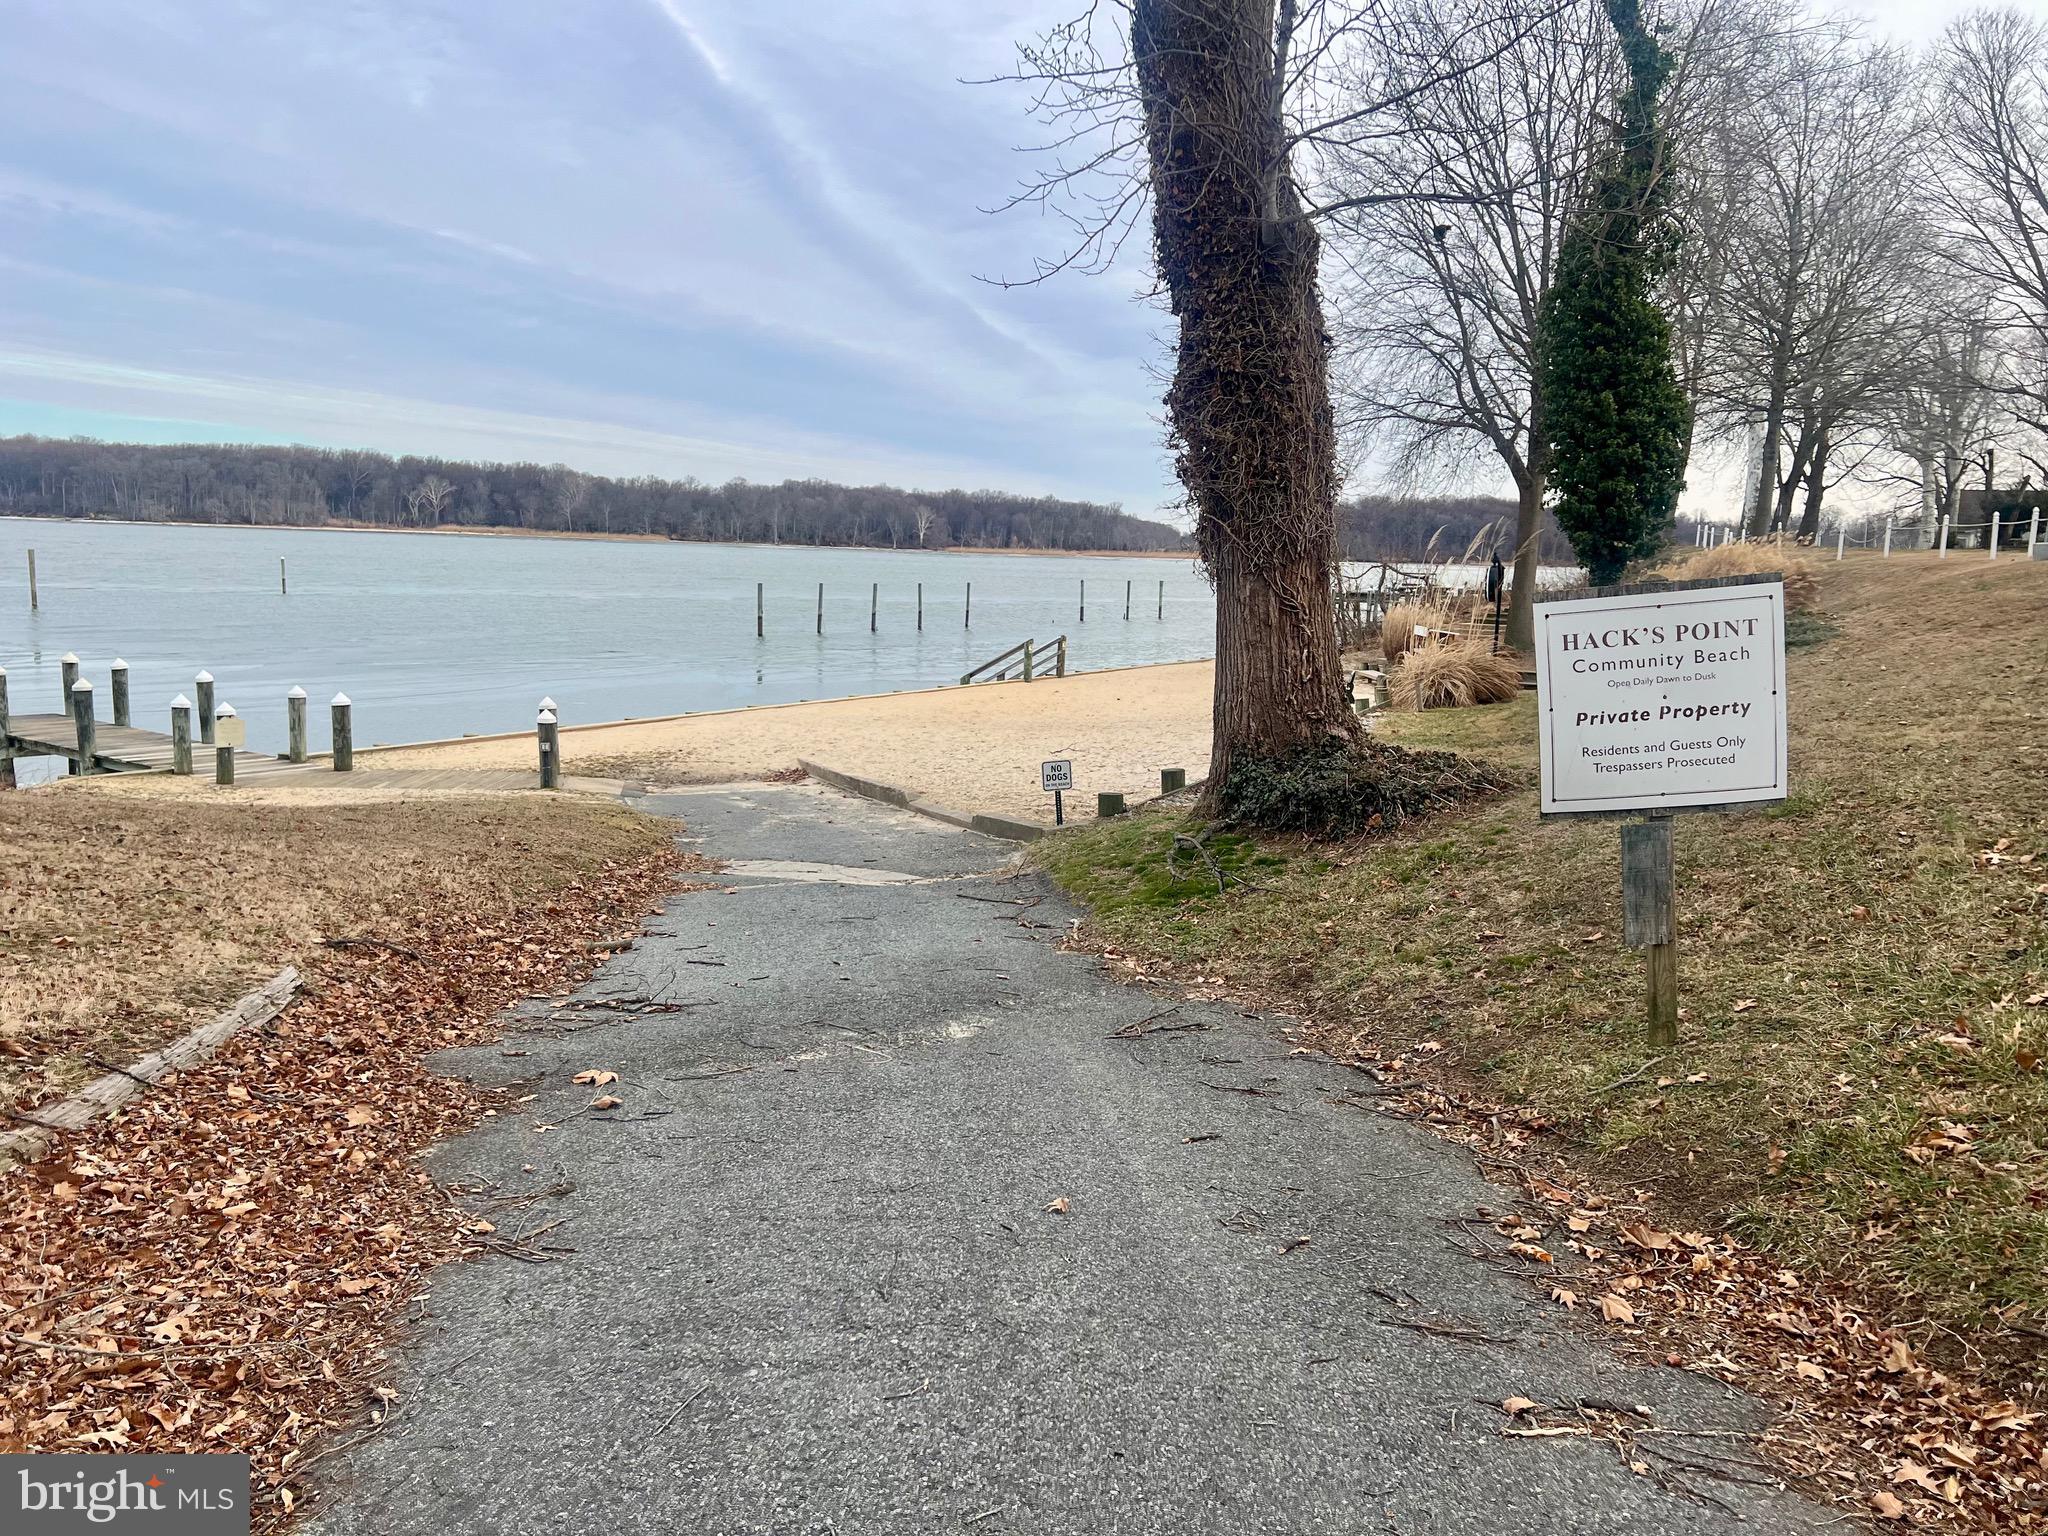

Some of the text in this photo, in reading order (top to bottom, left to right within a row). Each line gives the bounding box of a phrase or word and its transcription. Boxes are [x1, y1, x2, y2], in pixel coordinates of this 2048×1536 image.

[1562, 618, 1759, 651] HACK'S POINT
[1572, 646, 1751, 674] Community Beach
[1607, 679, 1631, 688] Open
[1633, 677, 1654, 686] Daily
[1656, 675, 1681, 684] Dawn
[1694, 672, 1716, 681] Dusk
[1576, 702, 1752, 726] Private Property
[1582, 736, 1746, 758] Residents and Guests Only
[1593, 754, 1736, 774] Trespassers Prosecuted
[1046, 773, 1068, 781] DOGS
